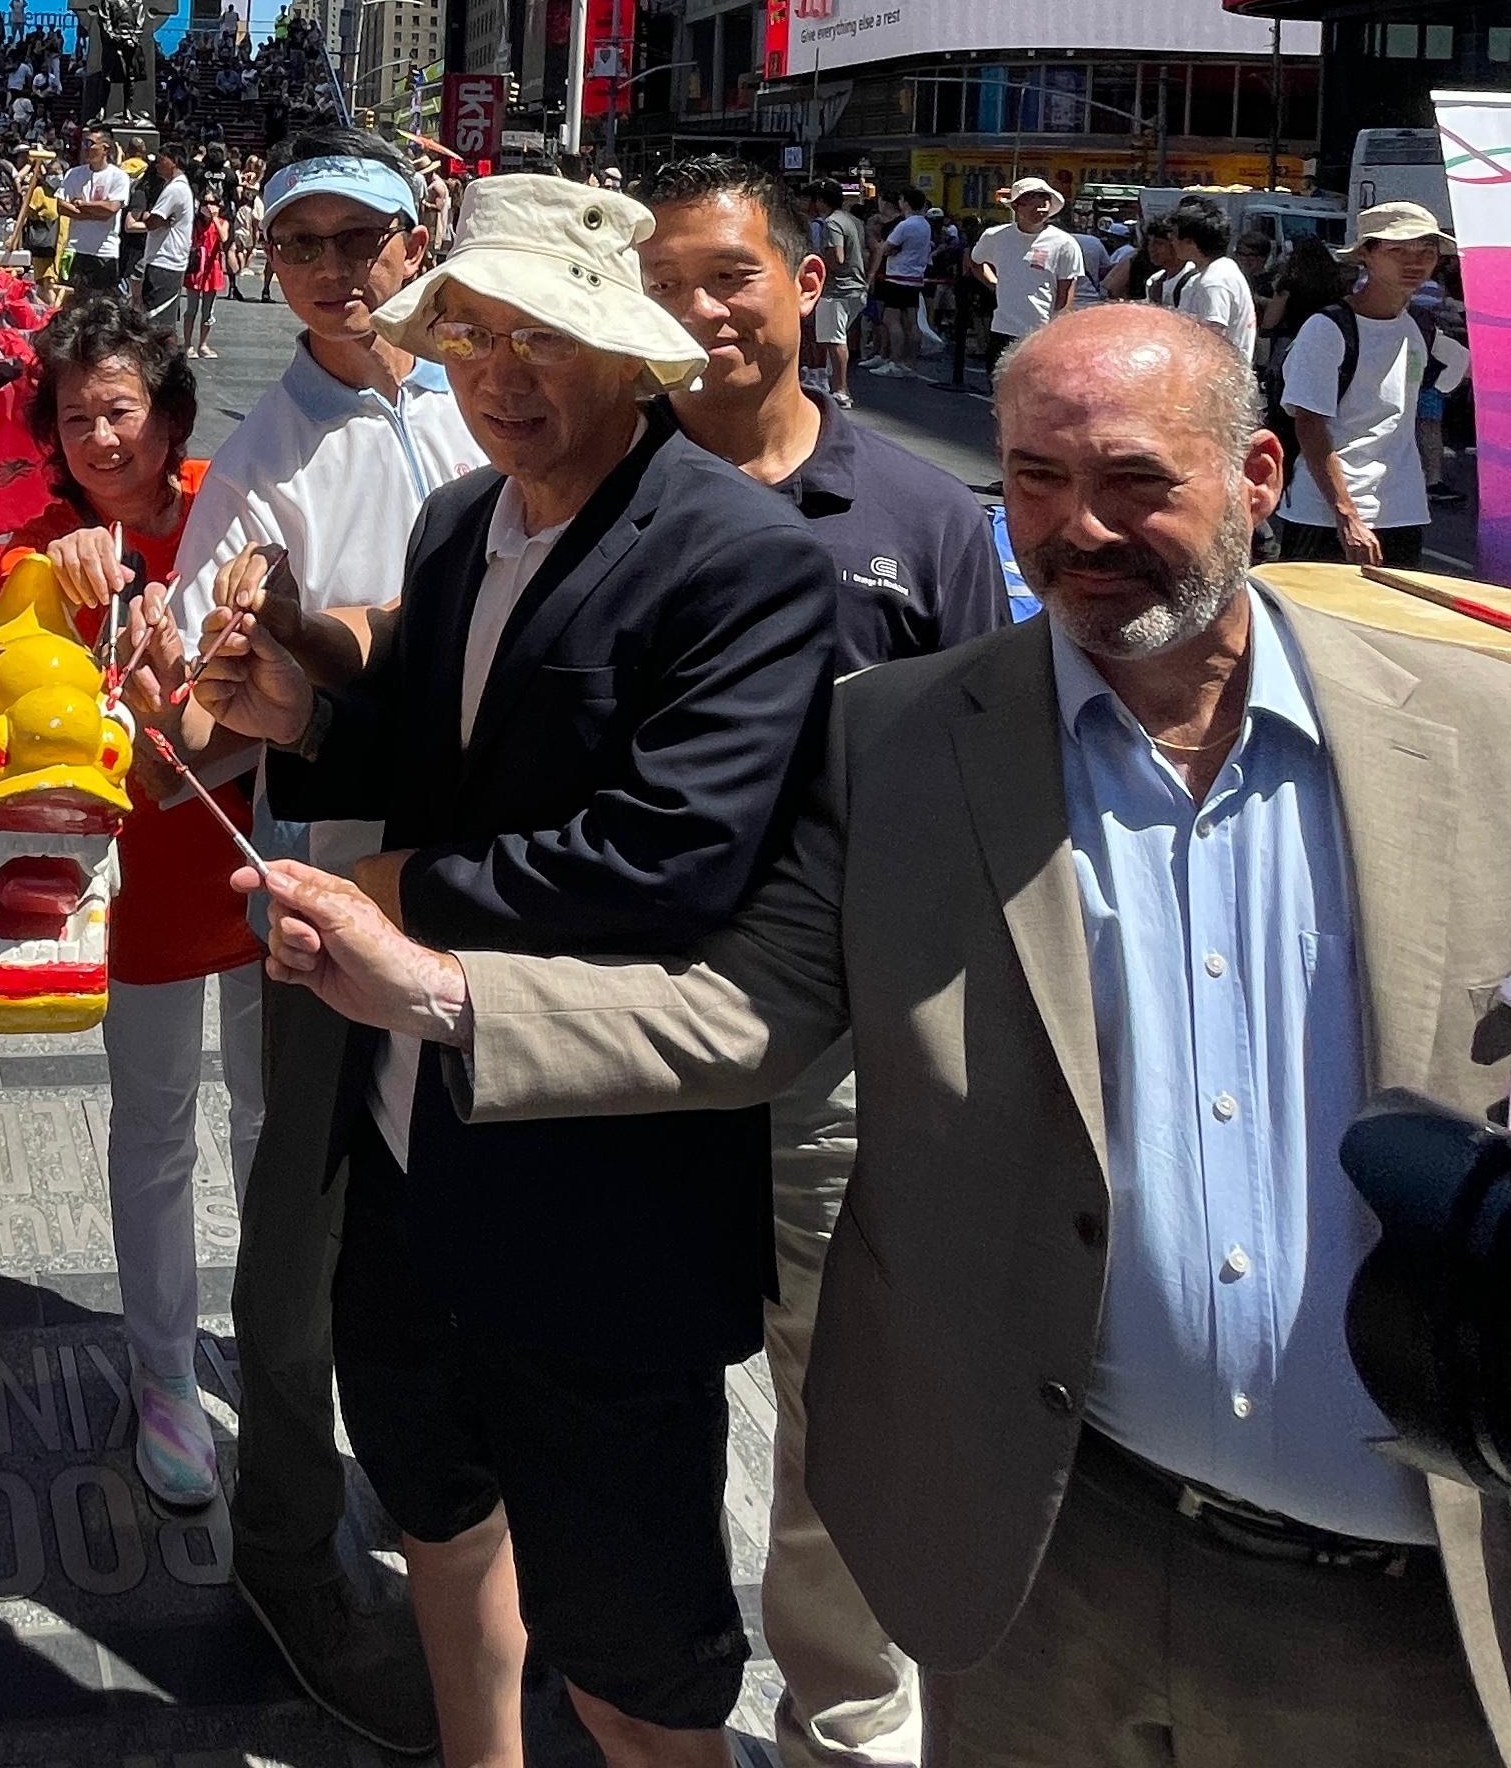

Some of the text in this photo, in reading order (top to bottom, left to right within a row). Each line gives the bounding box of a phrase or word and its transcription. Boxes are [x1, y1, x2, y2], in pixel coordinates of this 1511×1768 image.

[817, 19, 858, 42] everything
[858, 13, 875, 31] else
[876, 15, 882, 27] a
[883, 9, 901, 26] rest
[456, 79, 494, 153] tkts
